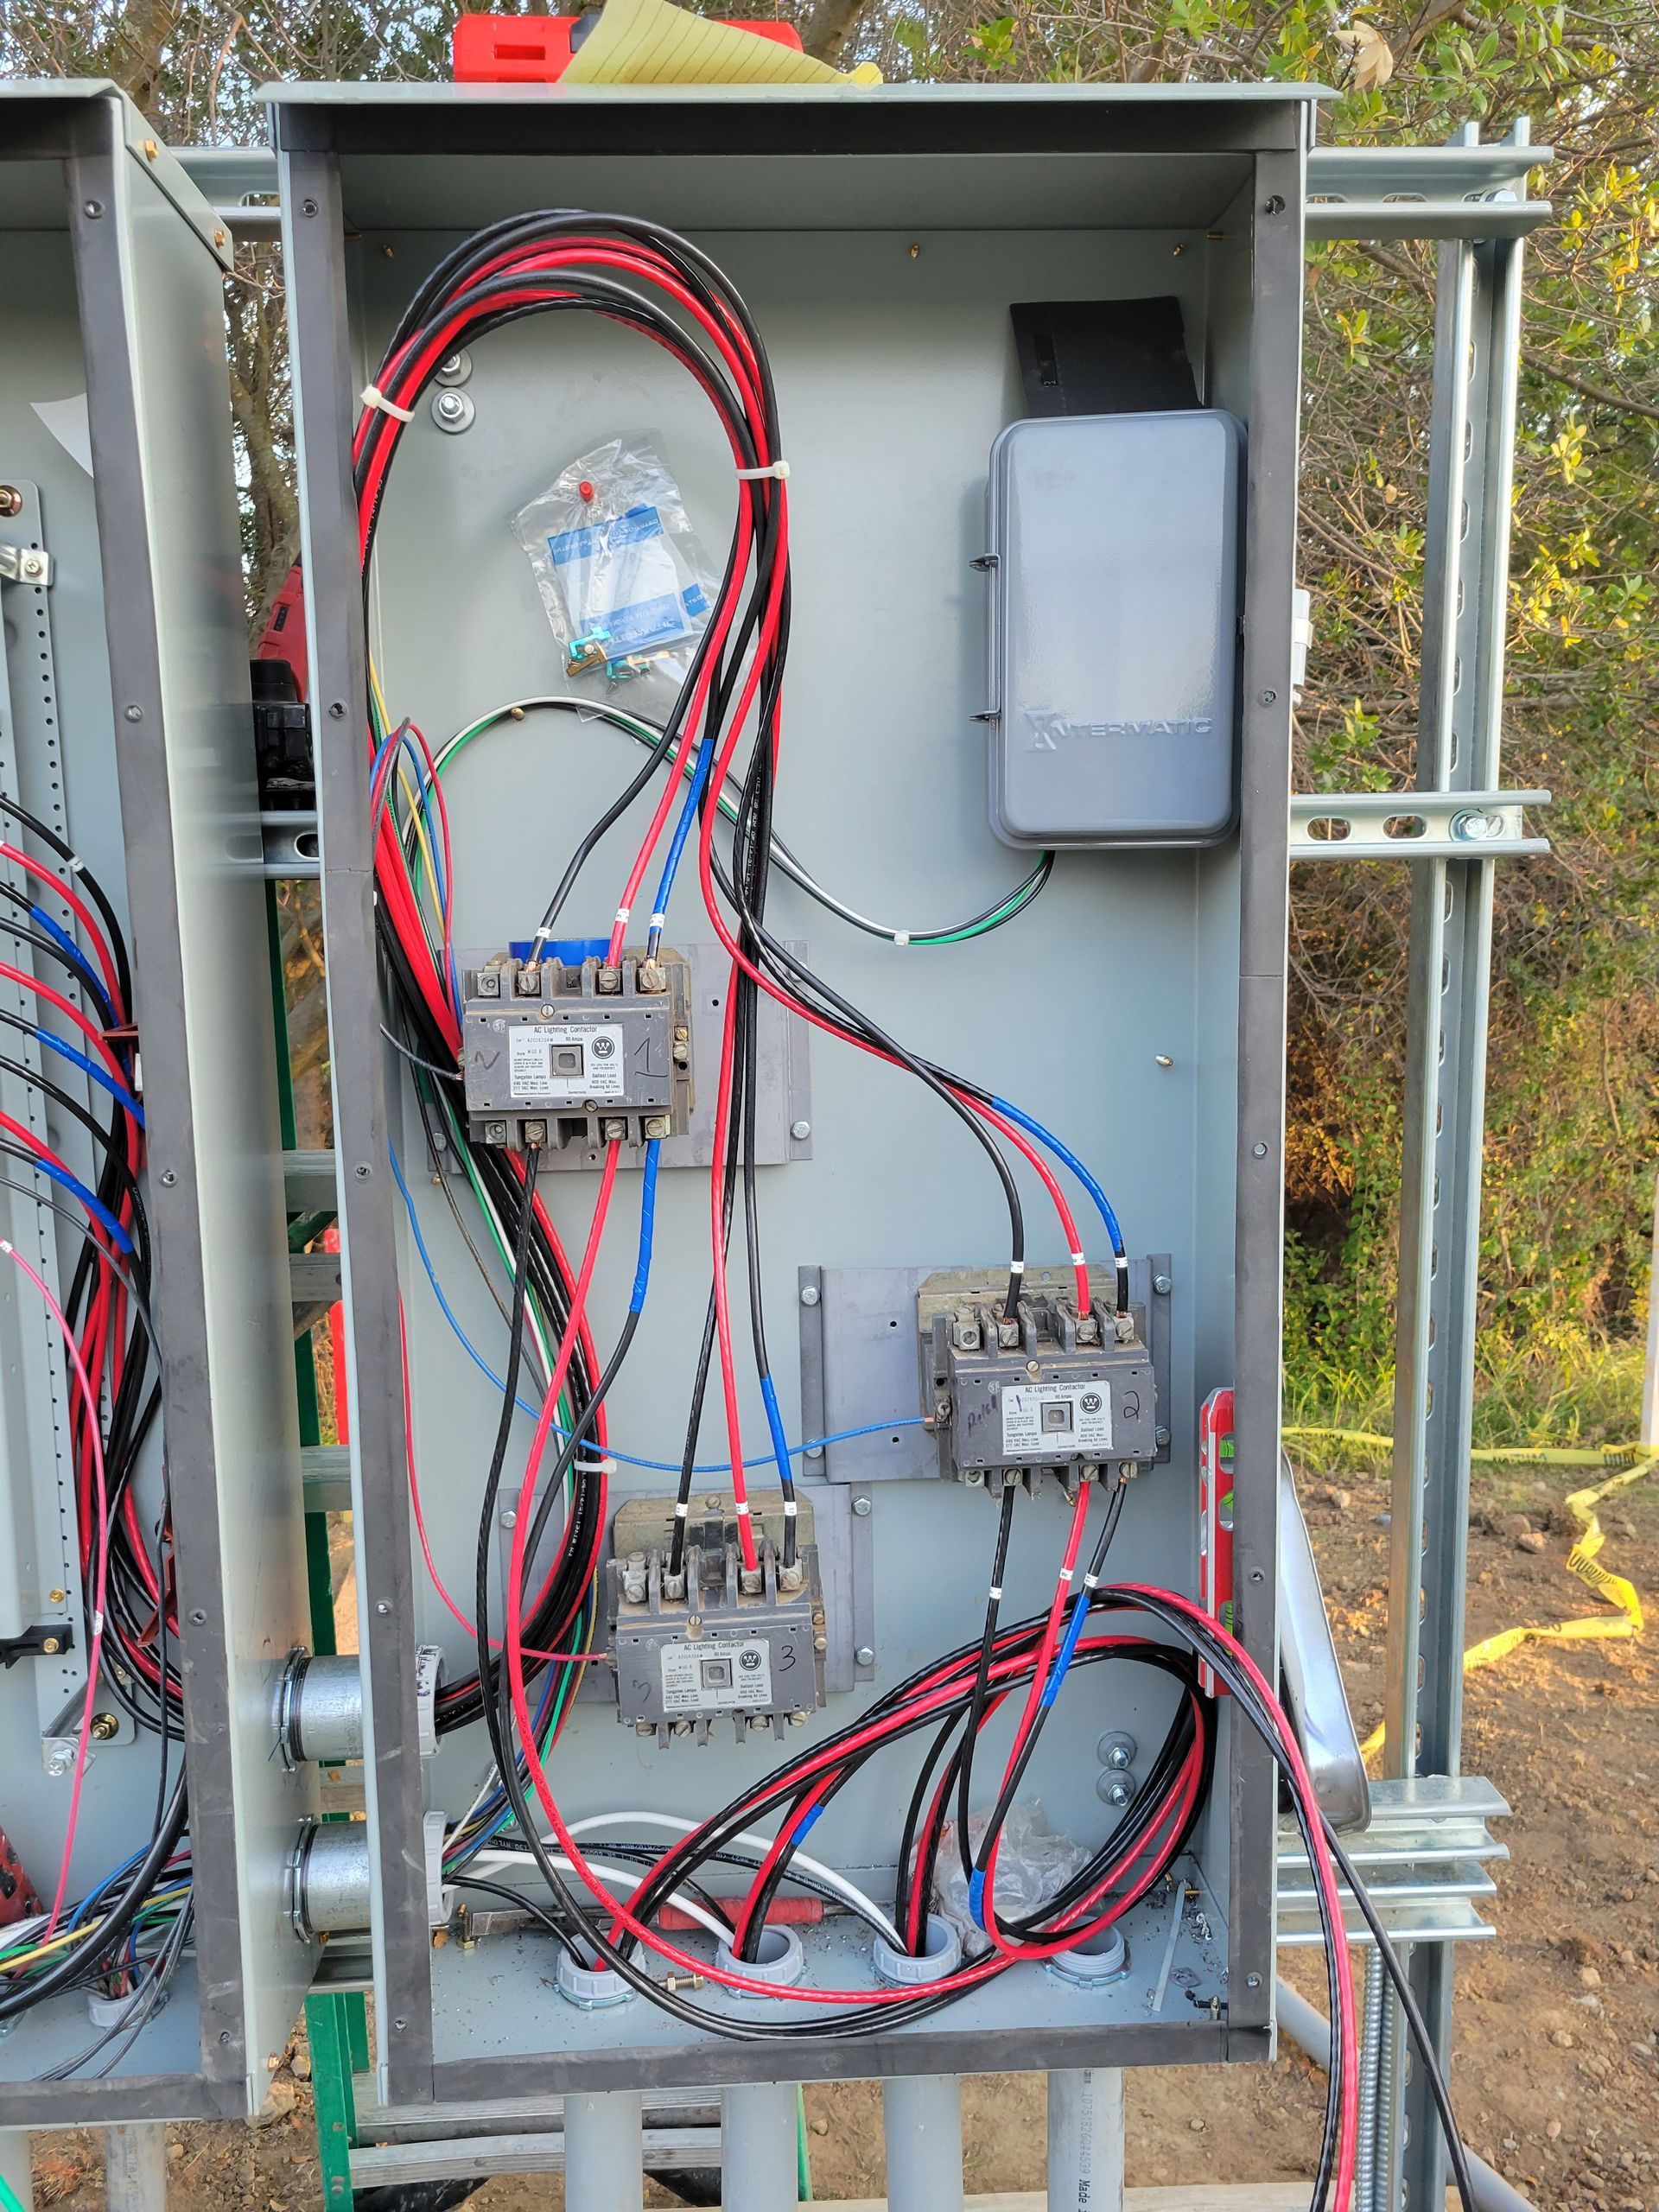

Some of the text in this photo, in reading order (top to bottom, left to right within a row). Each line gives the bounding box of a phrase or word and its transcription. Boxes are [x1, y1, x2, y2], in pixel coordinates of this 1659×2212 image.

[544, 1026, 567, 1034] Lighting
[1034, 1385, 1057, 1394] Lighting
[779, 1645, 796, 1672] 3
[1078, 2178, 1090, 2204] Made
